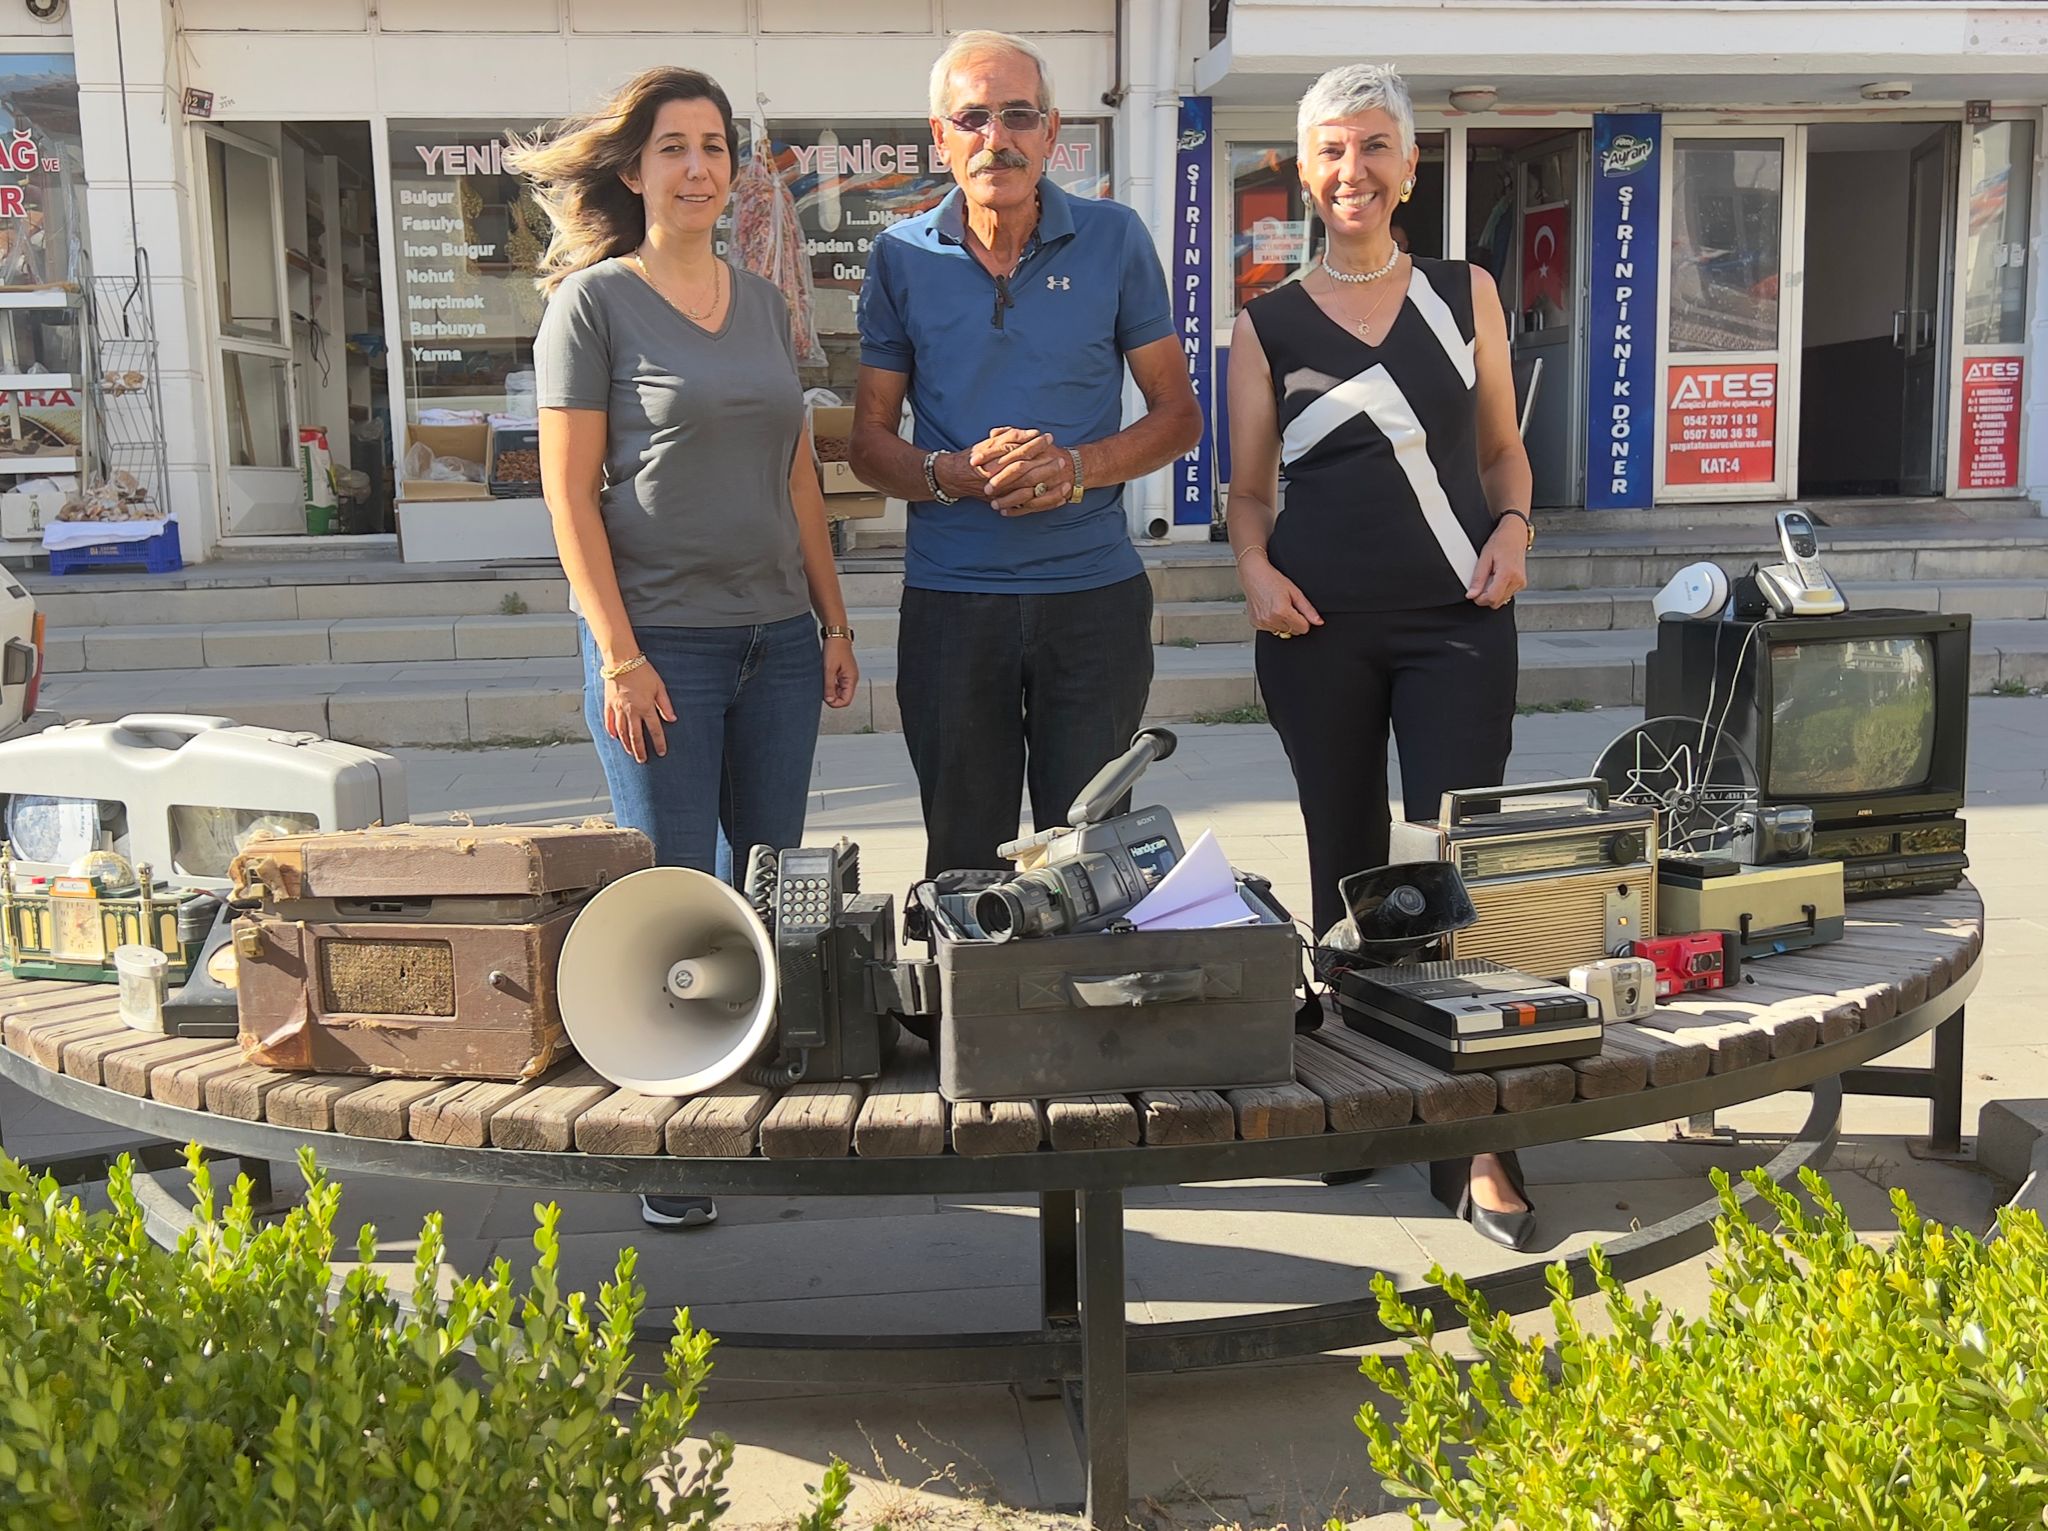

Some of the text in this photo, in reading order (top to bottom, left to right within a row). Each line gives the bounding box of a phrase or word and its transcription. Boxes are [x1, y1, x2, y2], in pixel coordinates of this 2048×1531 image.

[790, 138, 920, 175] YENİCE
[1609, 144, 1648, 166] Ayran
[41, 158, 60, 172] VE
[400, 190, 454, 207] Bulgur
[1186, 164, 1201, 266] ŞİRİN
[402, 216, 464, 233] Fasulye
[403, 240, 496, 259] İnce Bulgur
[406, 269, 455, 283] Nohut
[408, 295, 485, 309] Mercimek
[410, 321, 487, 337] Barbunya
[1611, 186, 1633, 494] ŞİRİN PİKNİK DÖNER
[411, 347, 463, 361] Yarma
[1683, 413, 1758, 427] 0542 737 18 18
[1683, 429, 1708, 441] 0507
[1710, 428, 1728, 440] 500
[1700, 457, 1740, 474] KAT:4
[1136, 815, 1156, 826] SONY
[1130, 839, 1168, 857] Handycam
